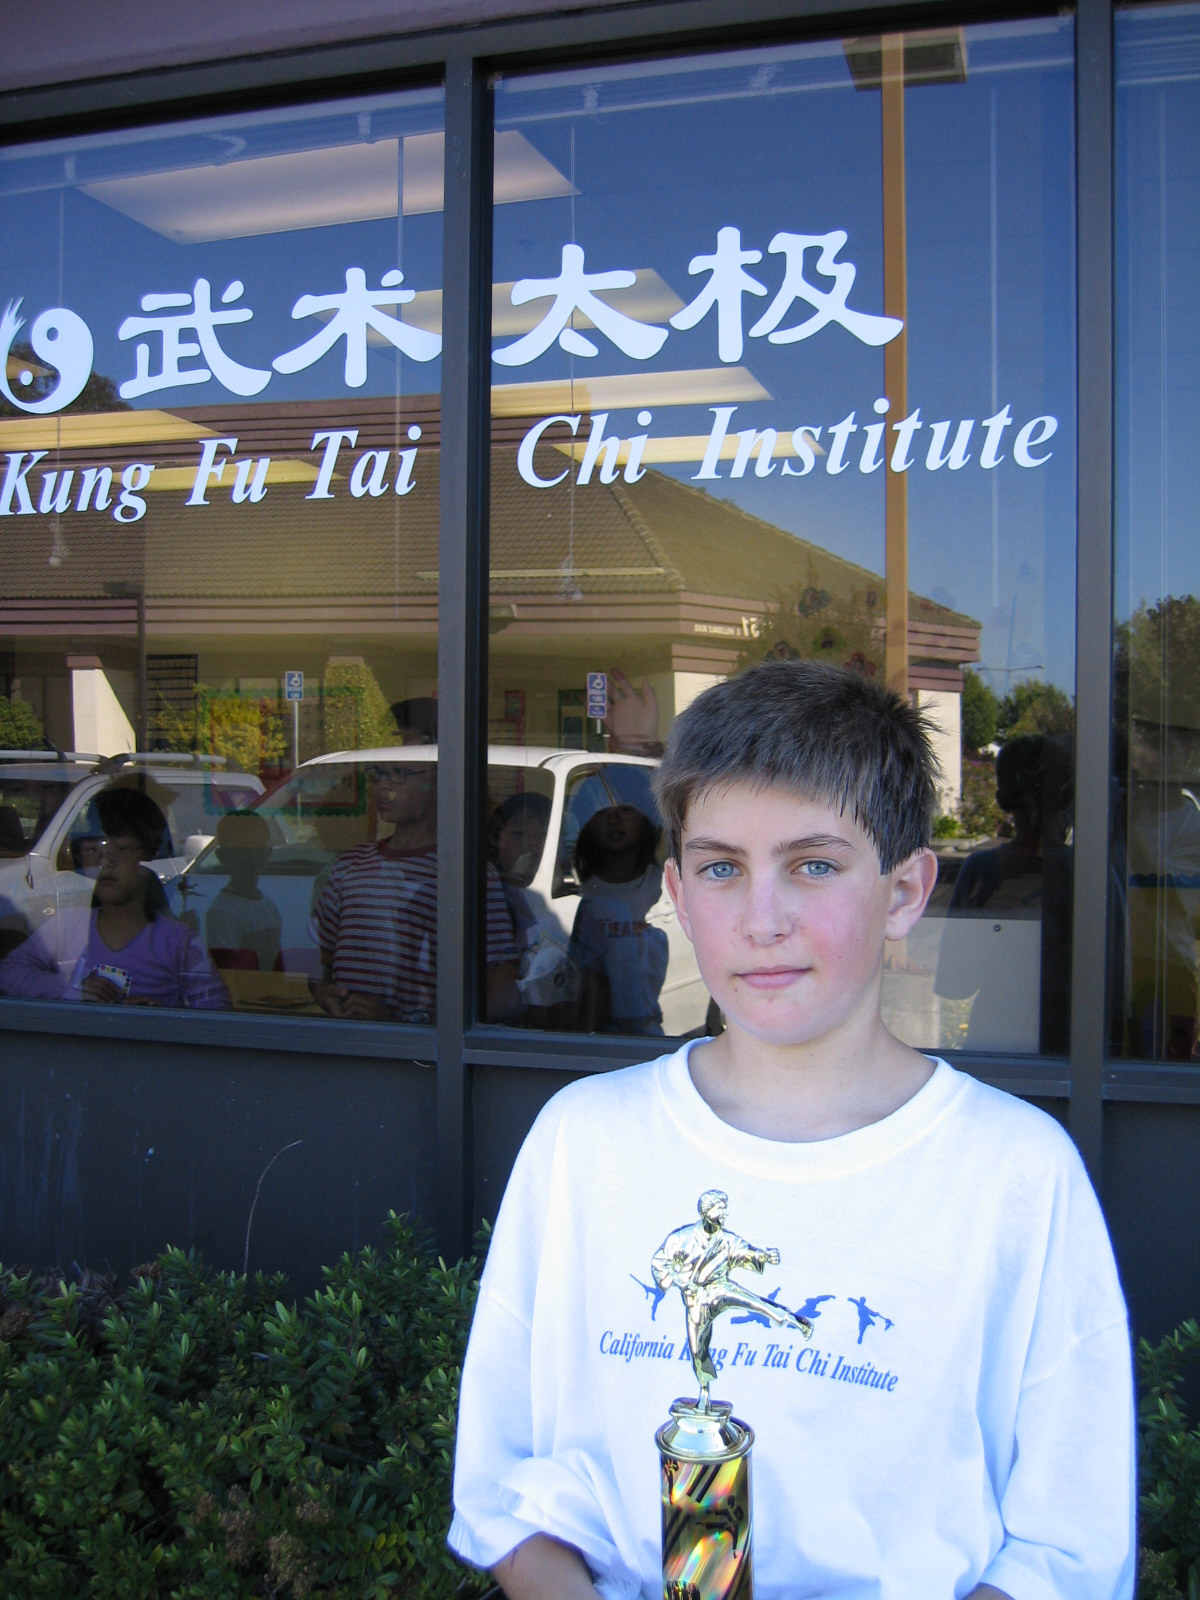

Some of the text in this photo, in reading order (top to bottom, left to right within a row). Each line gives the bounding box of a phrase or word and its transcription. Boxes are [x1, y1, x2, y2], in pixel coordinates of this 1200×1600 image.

[0, 398, 1058, 524] Kung Fu Tai Chi Institute
[599, 1330, 675, 1363] California
[730, 1342, 757, 1366] Fu
[761, 1343, 793, 1369] Tai
[795, 1347, 831, 1377] Chi
[829, 1355, 898, 1392] Institute
